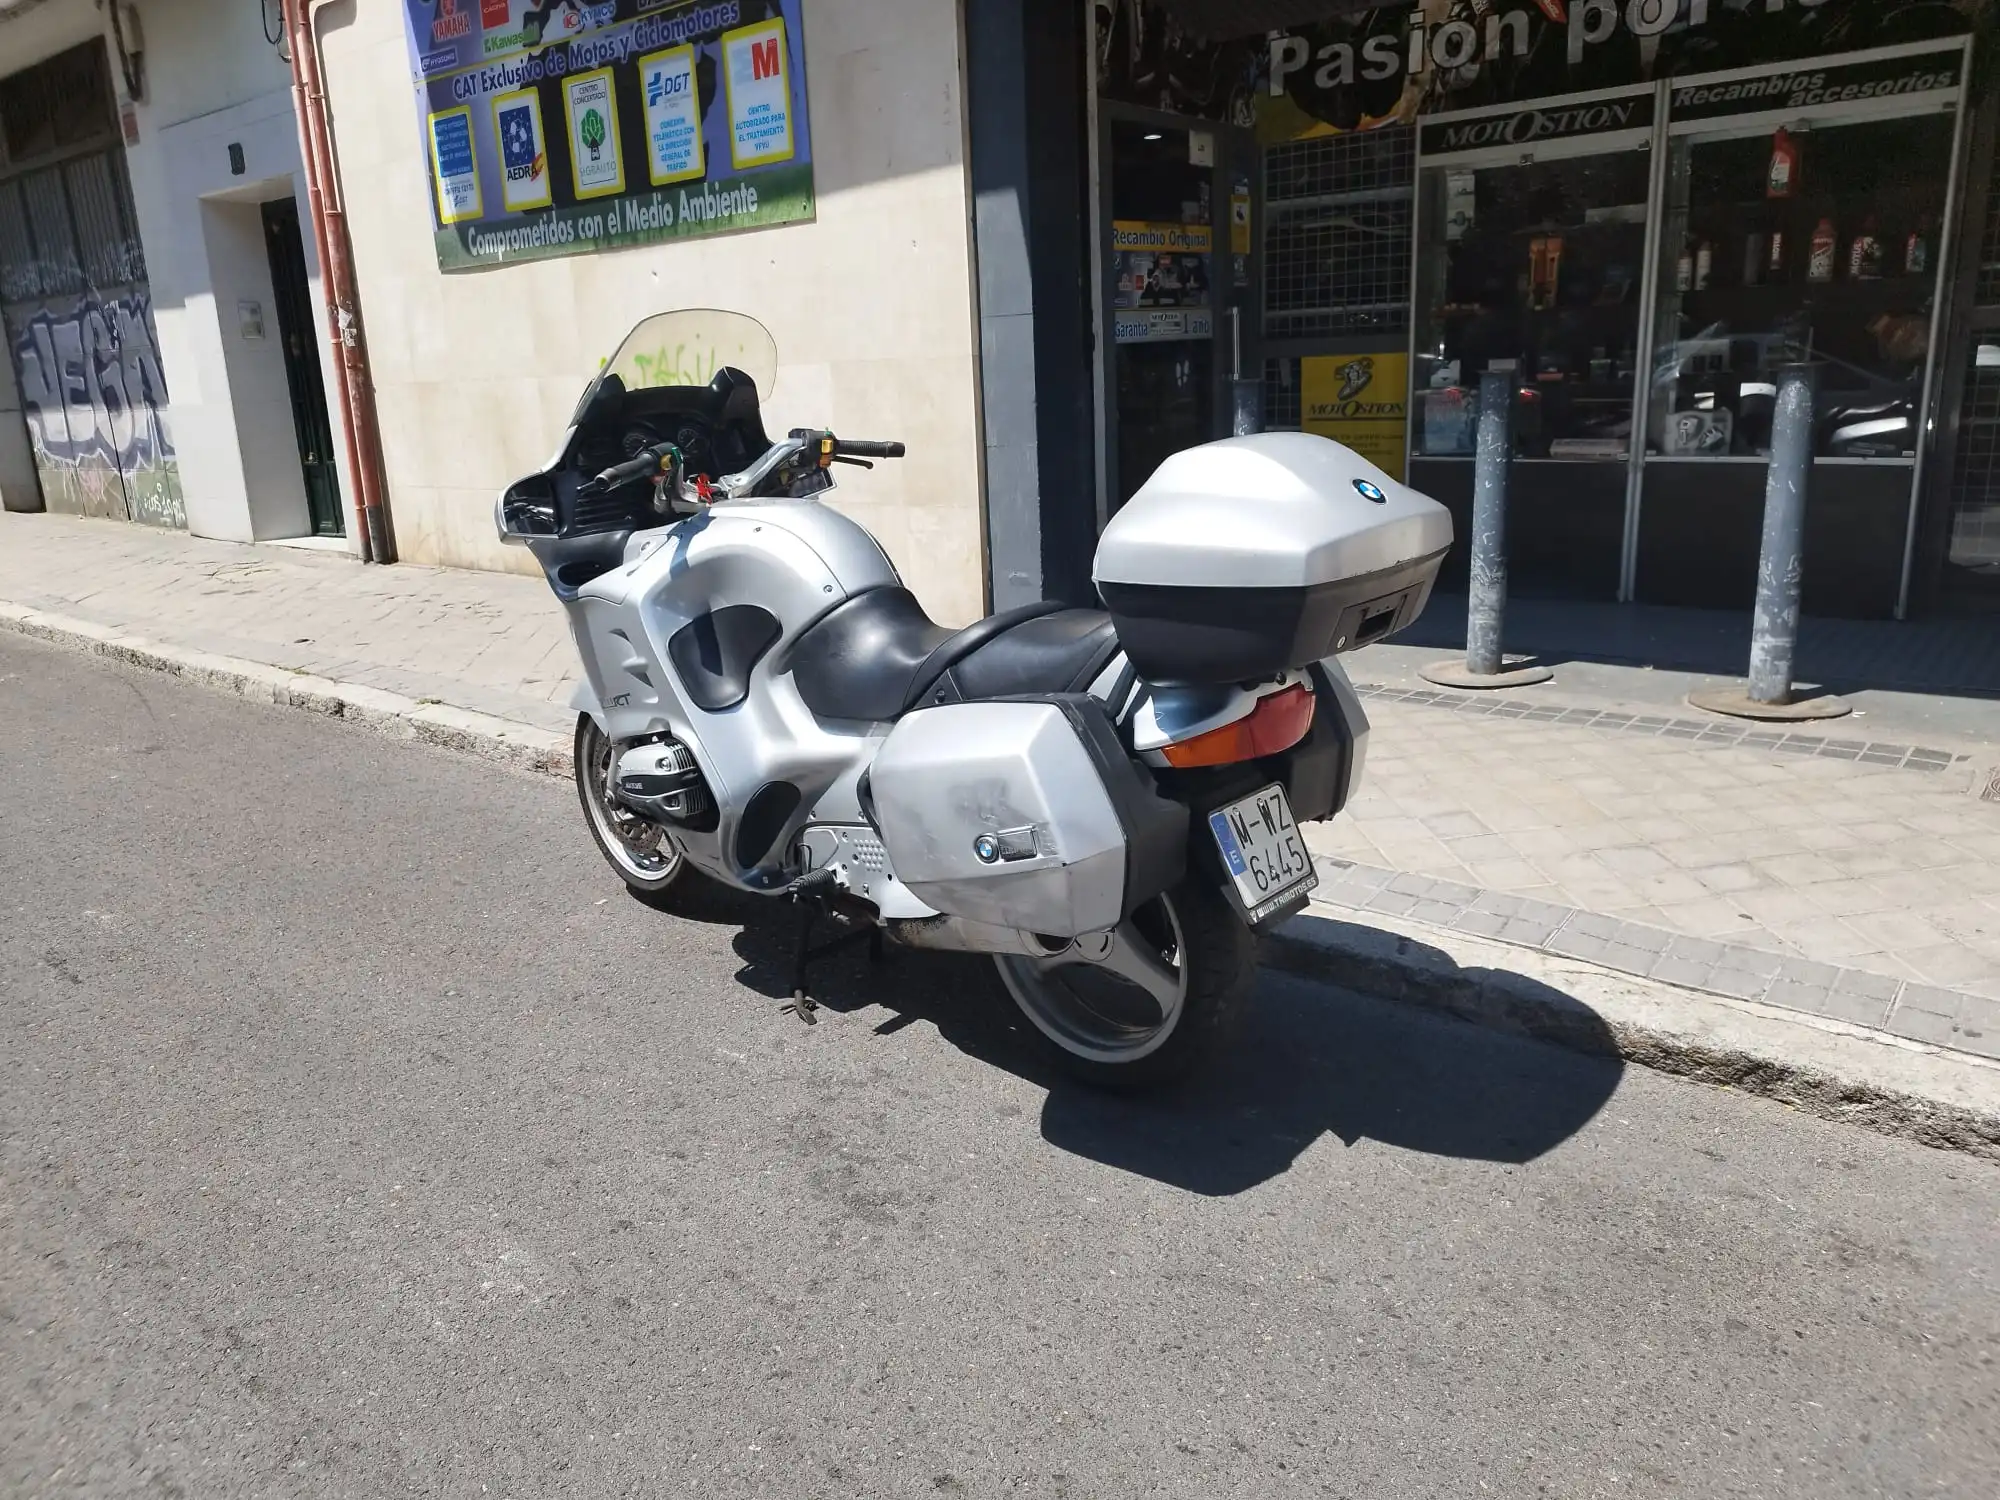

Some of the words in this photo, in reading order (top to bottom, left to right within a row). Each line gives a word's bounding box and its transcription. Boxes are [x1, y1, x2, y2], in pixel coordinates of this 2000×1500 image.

[579, 2, 616, 25] KYMCO
[432, 12, 471, 41] YAMAHA
[453, 74, 477, 100] CAT
[482, 58, 544, 92] Exclusivo
[549, 49, 566, 75] de
[569, 40, 615, 69] Motos
[619, 36, 631, 63] y
[634, 3, 739, 49] Ciclomotores
[752, 38, 780, 80] M
[1268, 3, 1529, 97] Pasión
[664, 72, 690, 95] DGT
[1674, 71, 1826, 107] Recambios
[1788, 70, 1955, 108] accesorios
[748, 104, 770, 115] CENTRO
[736, 117, 770, 131] AUTORIZADO
[771, 112, 785, 124] PARA
[738, 134, 746, 142] EL
[746, 126, 785, 141] TRATAMIENTO
[507, 164, 537, 182] AEDRA
[468, 210, 575, 260] Comprometidos
[578, 214, 604, 239] con
[607, 199, 621, 236] el
[625, 192, 674, 232] Medio
[679, 182, 758, 223] Ambiente
[1112, 228, 1165, 245] Recambio
[1169, 230, 1209, 250] Original
[1309, 401, 1404, 417] MOTOSTION
[1229, 850, 1240, 864] E
[1249, 835, 1305, 892] 6445
